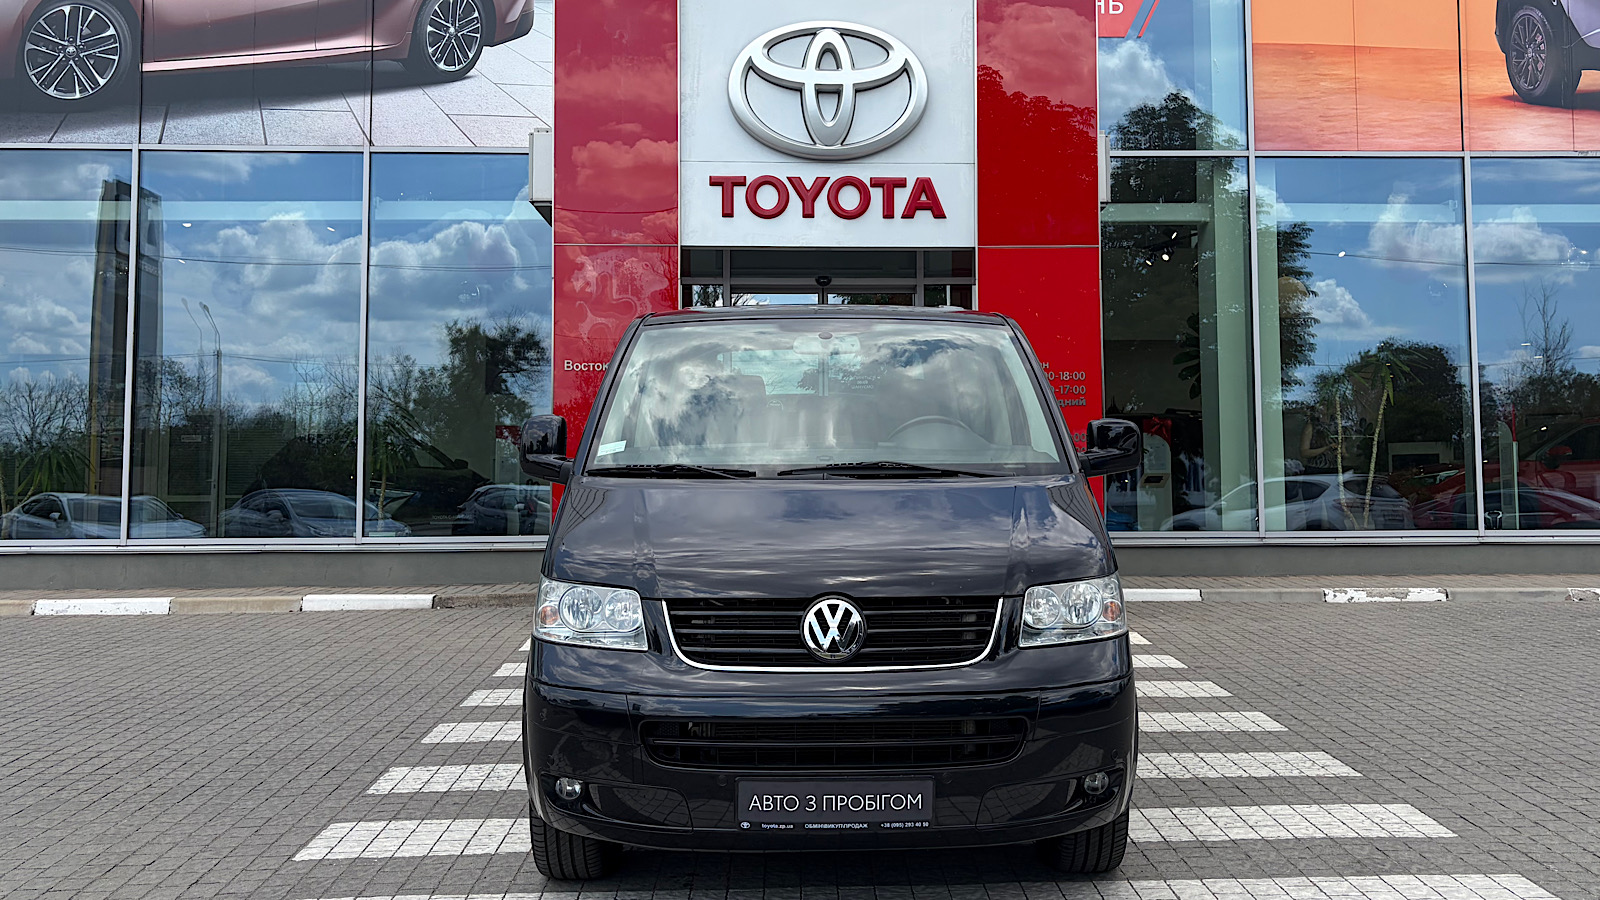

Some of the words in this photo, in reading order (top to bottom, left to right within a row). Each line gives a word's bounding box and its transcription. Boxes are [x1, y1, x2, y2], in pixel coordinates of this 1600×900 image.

[709, 174, 947, 220] TOYOTA
[748, 794, 800, 812] АВТО
[805, 794, 817, 812] З
[822, 793, 922, 811] ПРОБІГОМ
